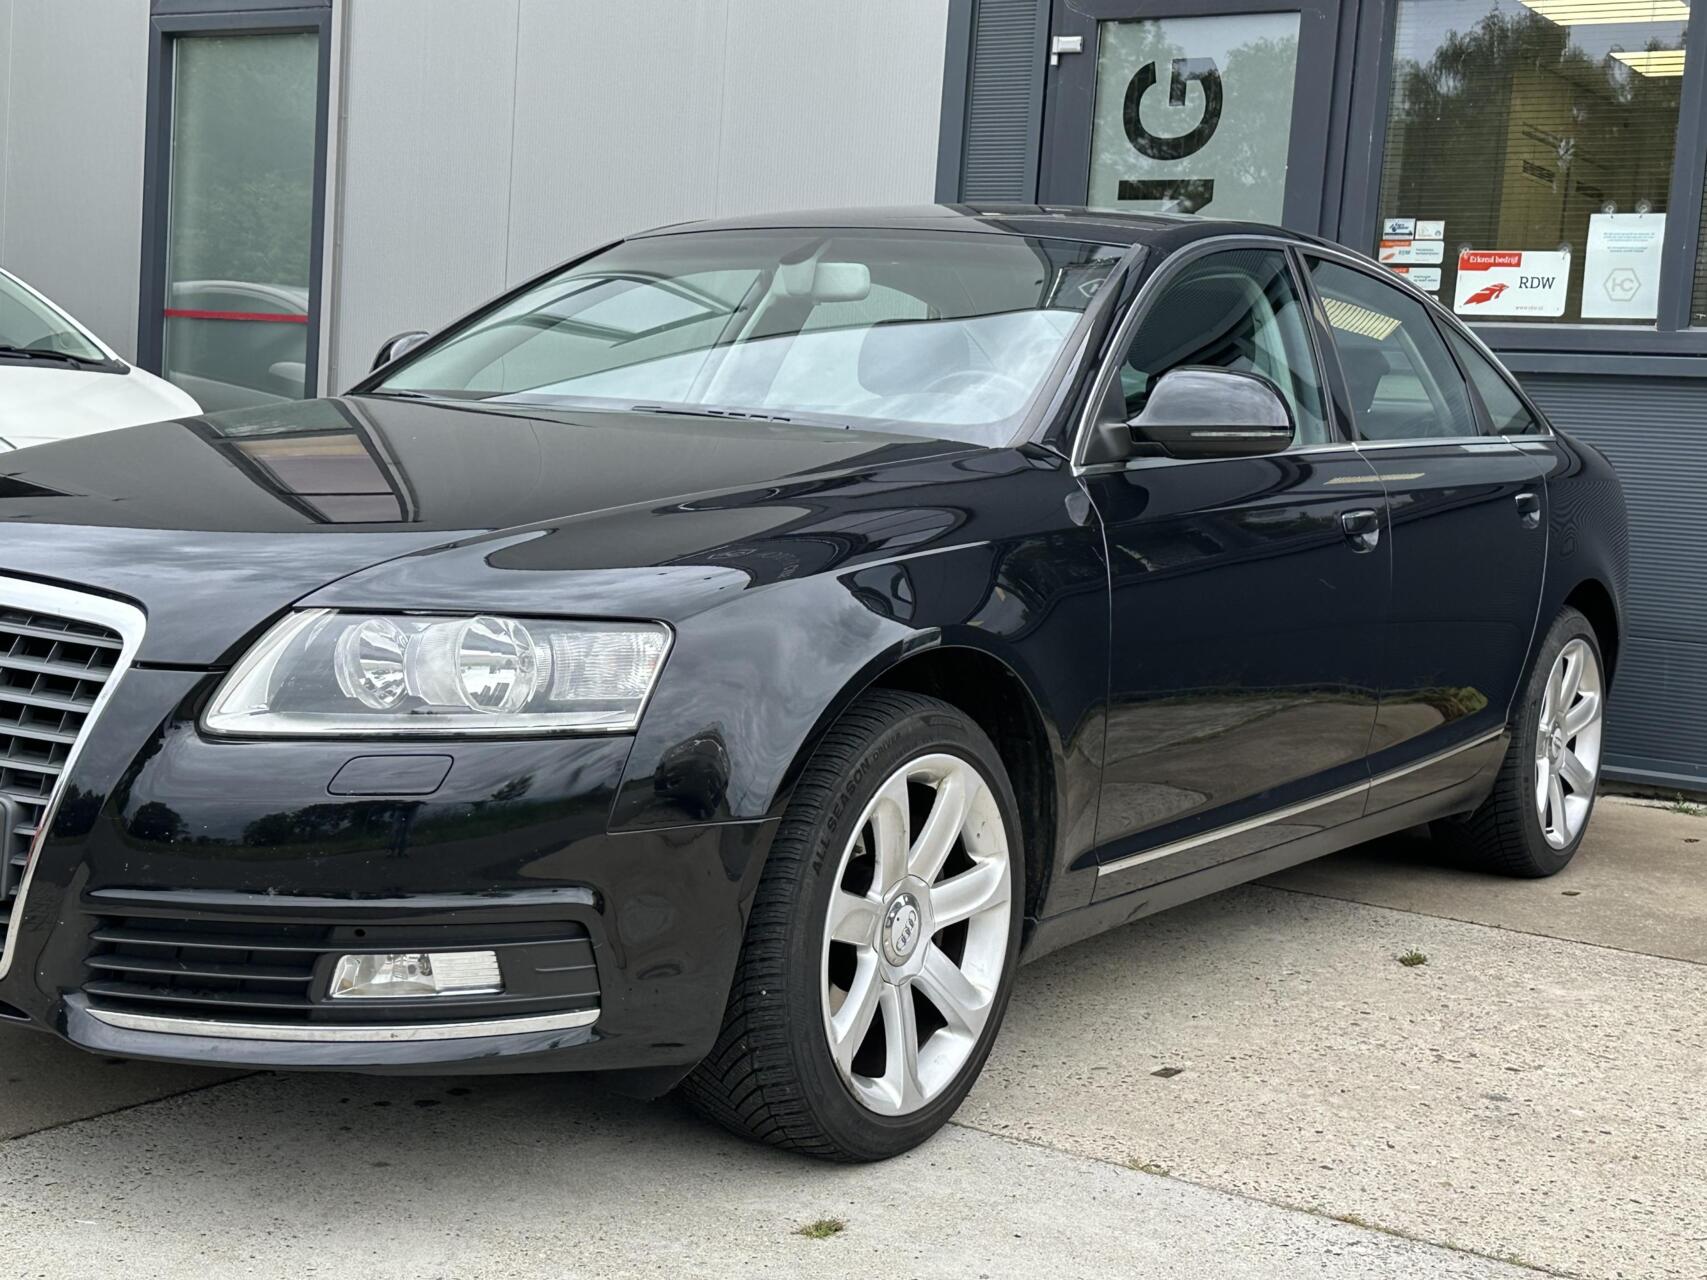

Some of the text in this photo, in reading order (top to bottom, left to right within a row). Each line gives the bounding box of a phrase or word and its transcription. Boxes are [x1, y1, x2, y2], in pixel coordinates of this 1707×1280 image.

[1496, 255, 1518, 265] bedrijf
[1519, 276, 1556, 290] RDW
[812, 833, 831, 877] ALL
[827, 758, 871, 834] SEASON
